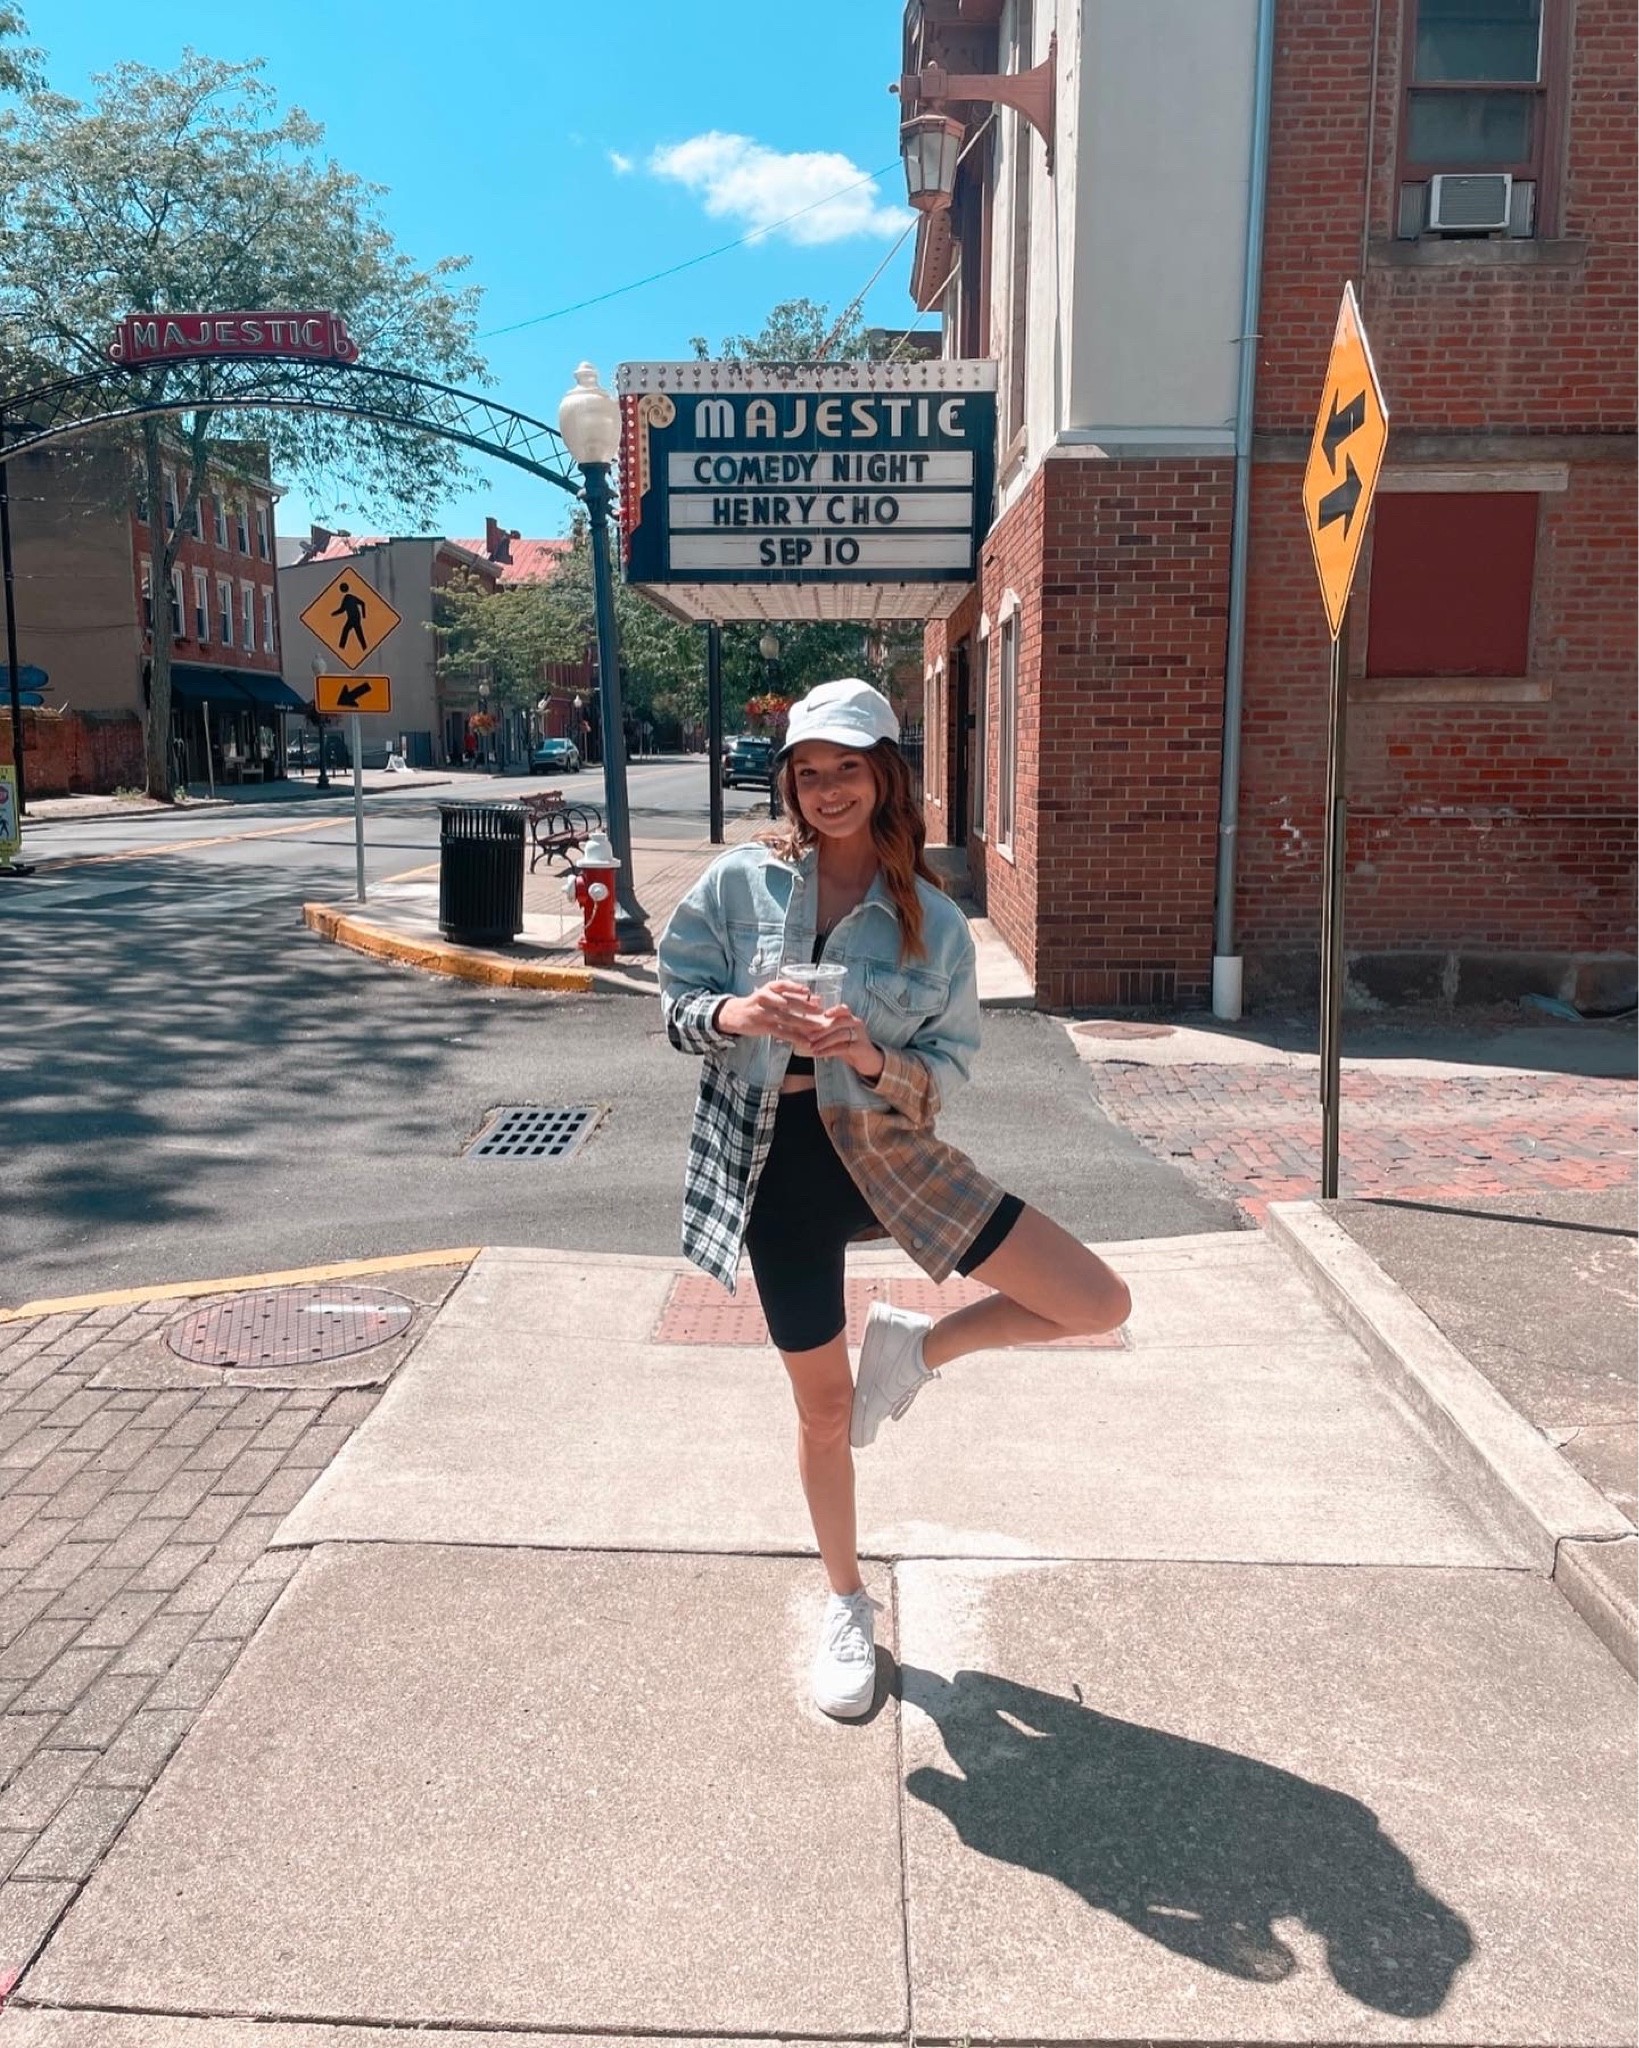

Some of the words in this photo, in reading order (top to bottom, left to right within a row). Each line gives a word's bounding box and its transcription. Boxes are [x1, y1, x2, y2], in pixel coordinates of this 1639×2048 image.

[133, 319, 323, 350] MAJESTIC
[695, 399, 966, 438] MAJESTIC
[694, 454, 818, 484] COMEDY
[832, 453, 930, 483] NIGHT
[713, 496, 816, 526] HENRY
[826, 495, 900, 525] CHO
[759, 537, 812, 567] SEP
[824, 537, 860, 566] 10
